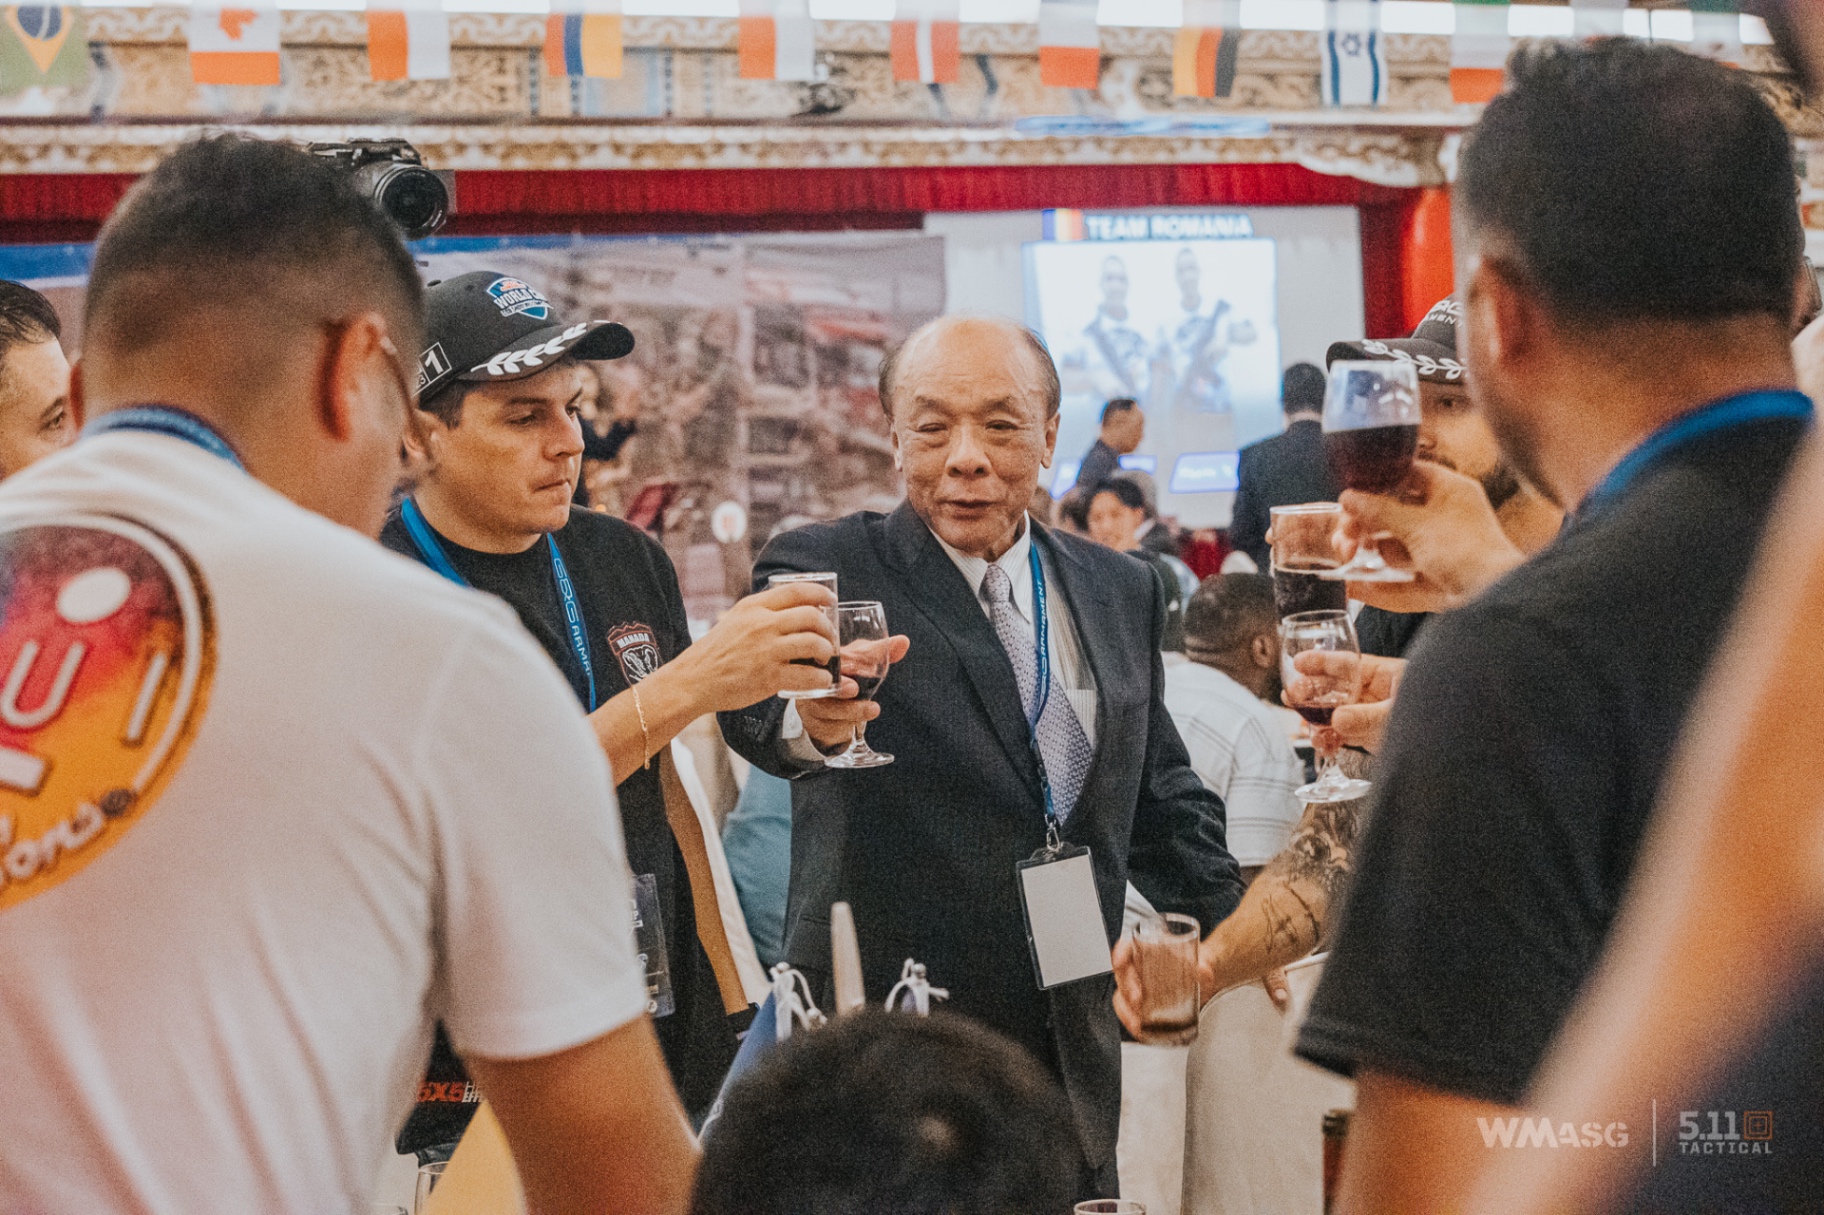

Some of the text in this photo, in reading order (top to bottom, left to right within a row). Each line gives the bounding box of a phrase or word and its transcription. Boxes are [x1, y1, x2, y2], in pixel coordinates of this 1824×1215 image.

[1086, 215, 1253, 239] TEAM ROMANIA
[494, 289, 533, 309] WORLD
[424, 350, 444, 374] 1
[1037, 580, 1048, 656] ARMAMENT
